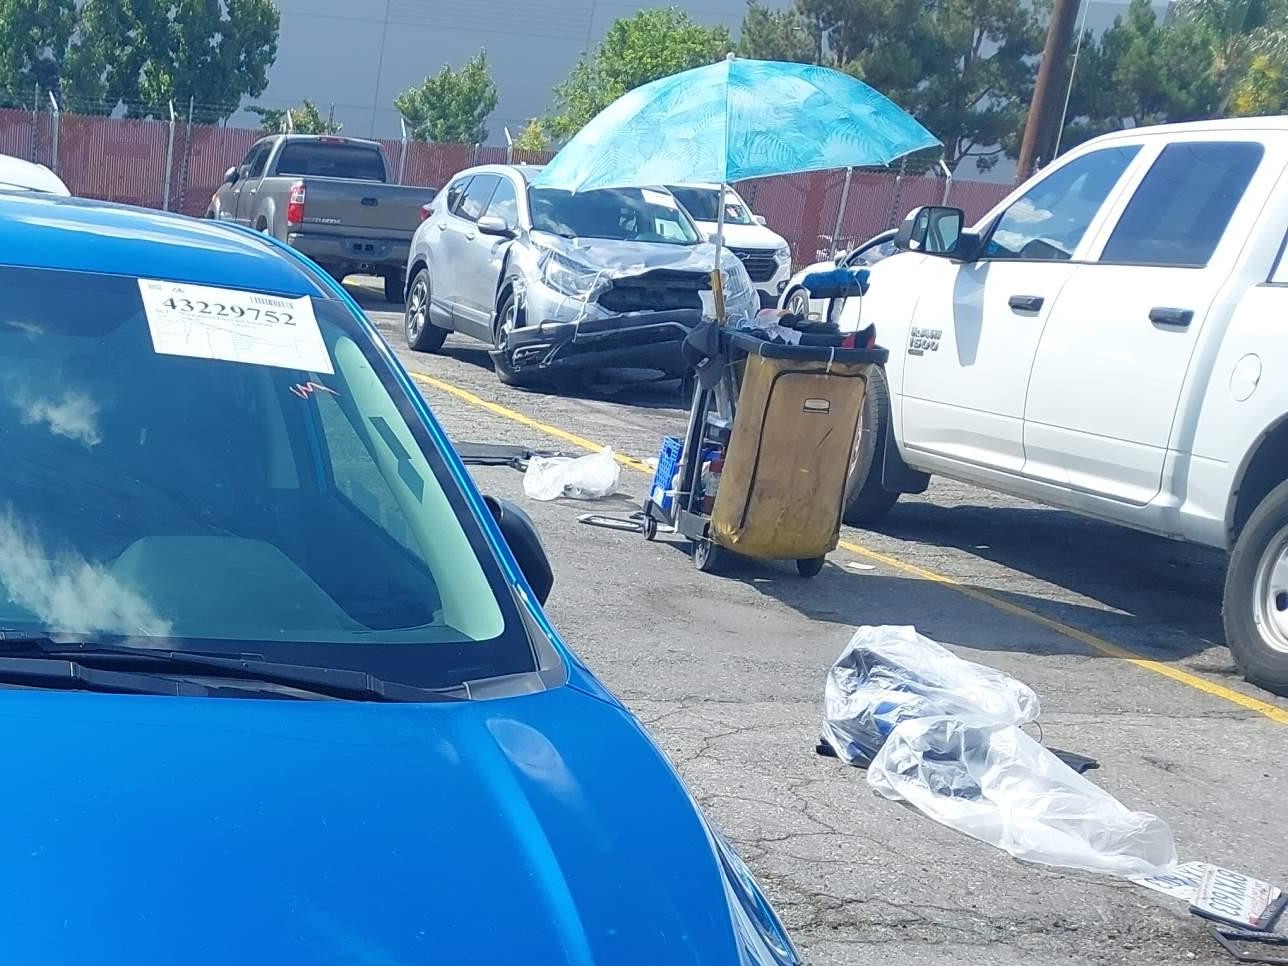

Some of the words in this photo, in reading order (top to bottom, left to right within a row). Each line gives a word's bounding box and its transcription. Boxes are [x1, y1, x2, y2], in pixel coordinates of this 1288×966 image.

[162, 297, 297, 327] 43229752
[911, 327, 943, 340] RAM
[909, 338, 940, 351] 1500
